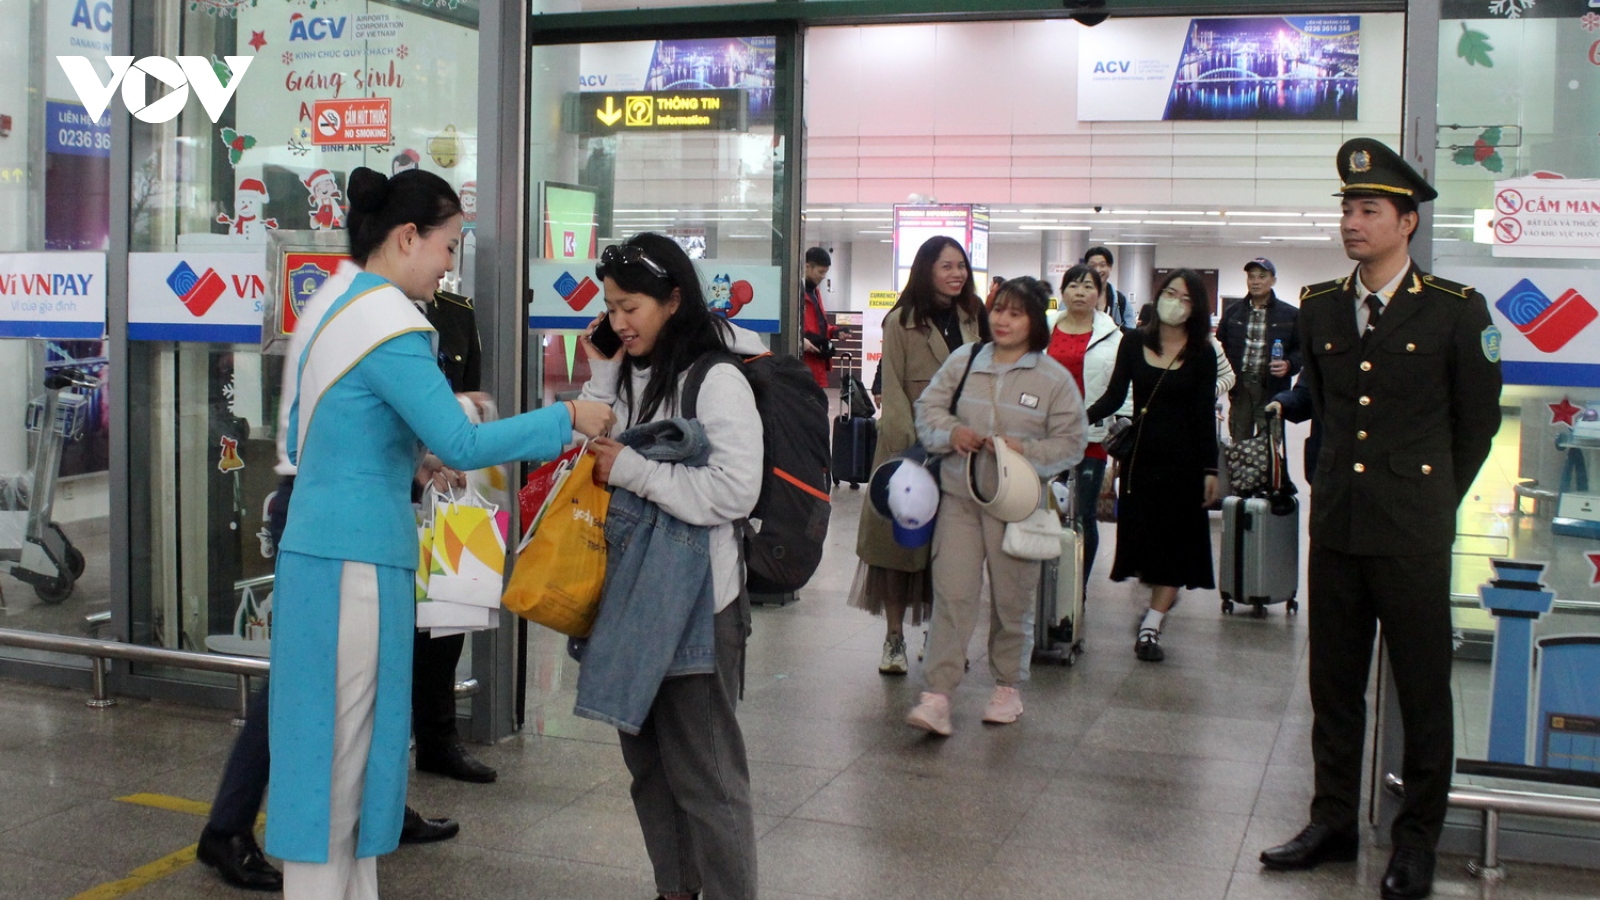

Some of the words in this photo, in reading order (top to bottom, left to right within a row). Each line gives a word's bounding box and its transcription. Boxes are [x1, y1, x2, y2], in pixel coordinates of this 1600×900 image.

[356, 14, 390, 22] AIRPORTS
[289, 17, 347, 41] ACV
[356, 22, 404, 30] CORPORATION
[1093, 60, 1130, 73] ACV
[285, 69, 347, 98] Giáng
[353, 59, 405, 91] sinh
[656, 95, 699, 110] THÔNG
[701, 97, 720, 110] TIN
[58, 110, 79, 124] LIÊN
[344, 104, 357, 125] CẤM
[358, 105, 368, 125] HÚT
[369, 103, 387, 125] THUỐC
[657, 115, 710, 126] Information
[59, 128, 92, 148] 0236
[344, 130, 354, 138] NO
[355, 128, 387, 138] SMOKING
[1525, 196, 1560, 213] CẤM
[20, 273, 94, 295] VNPAY
